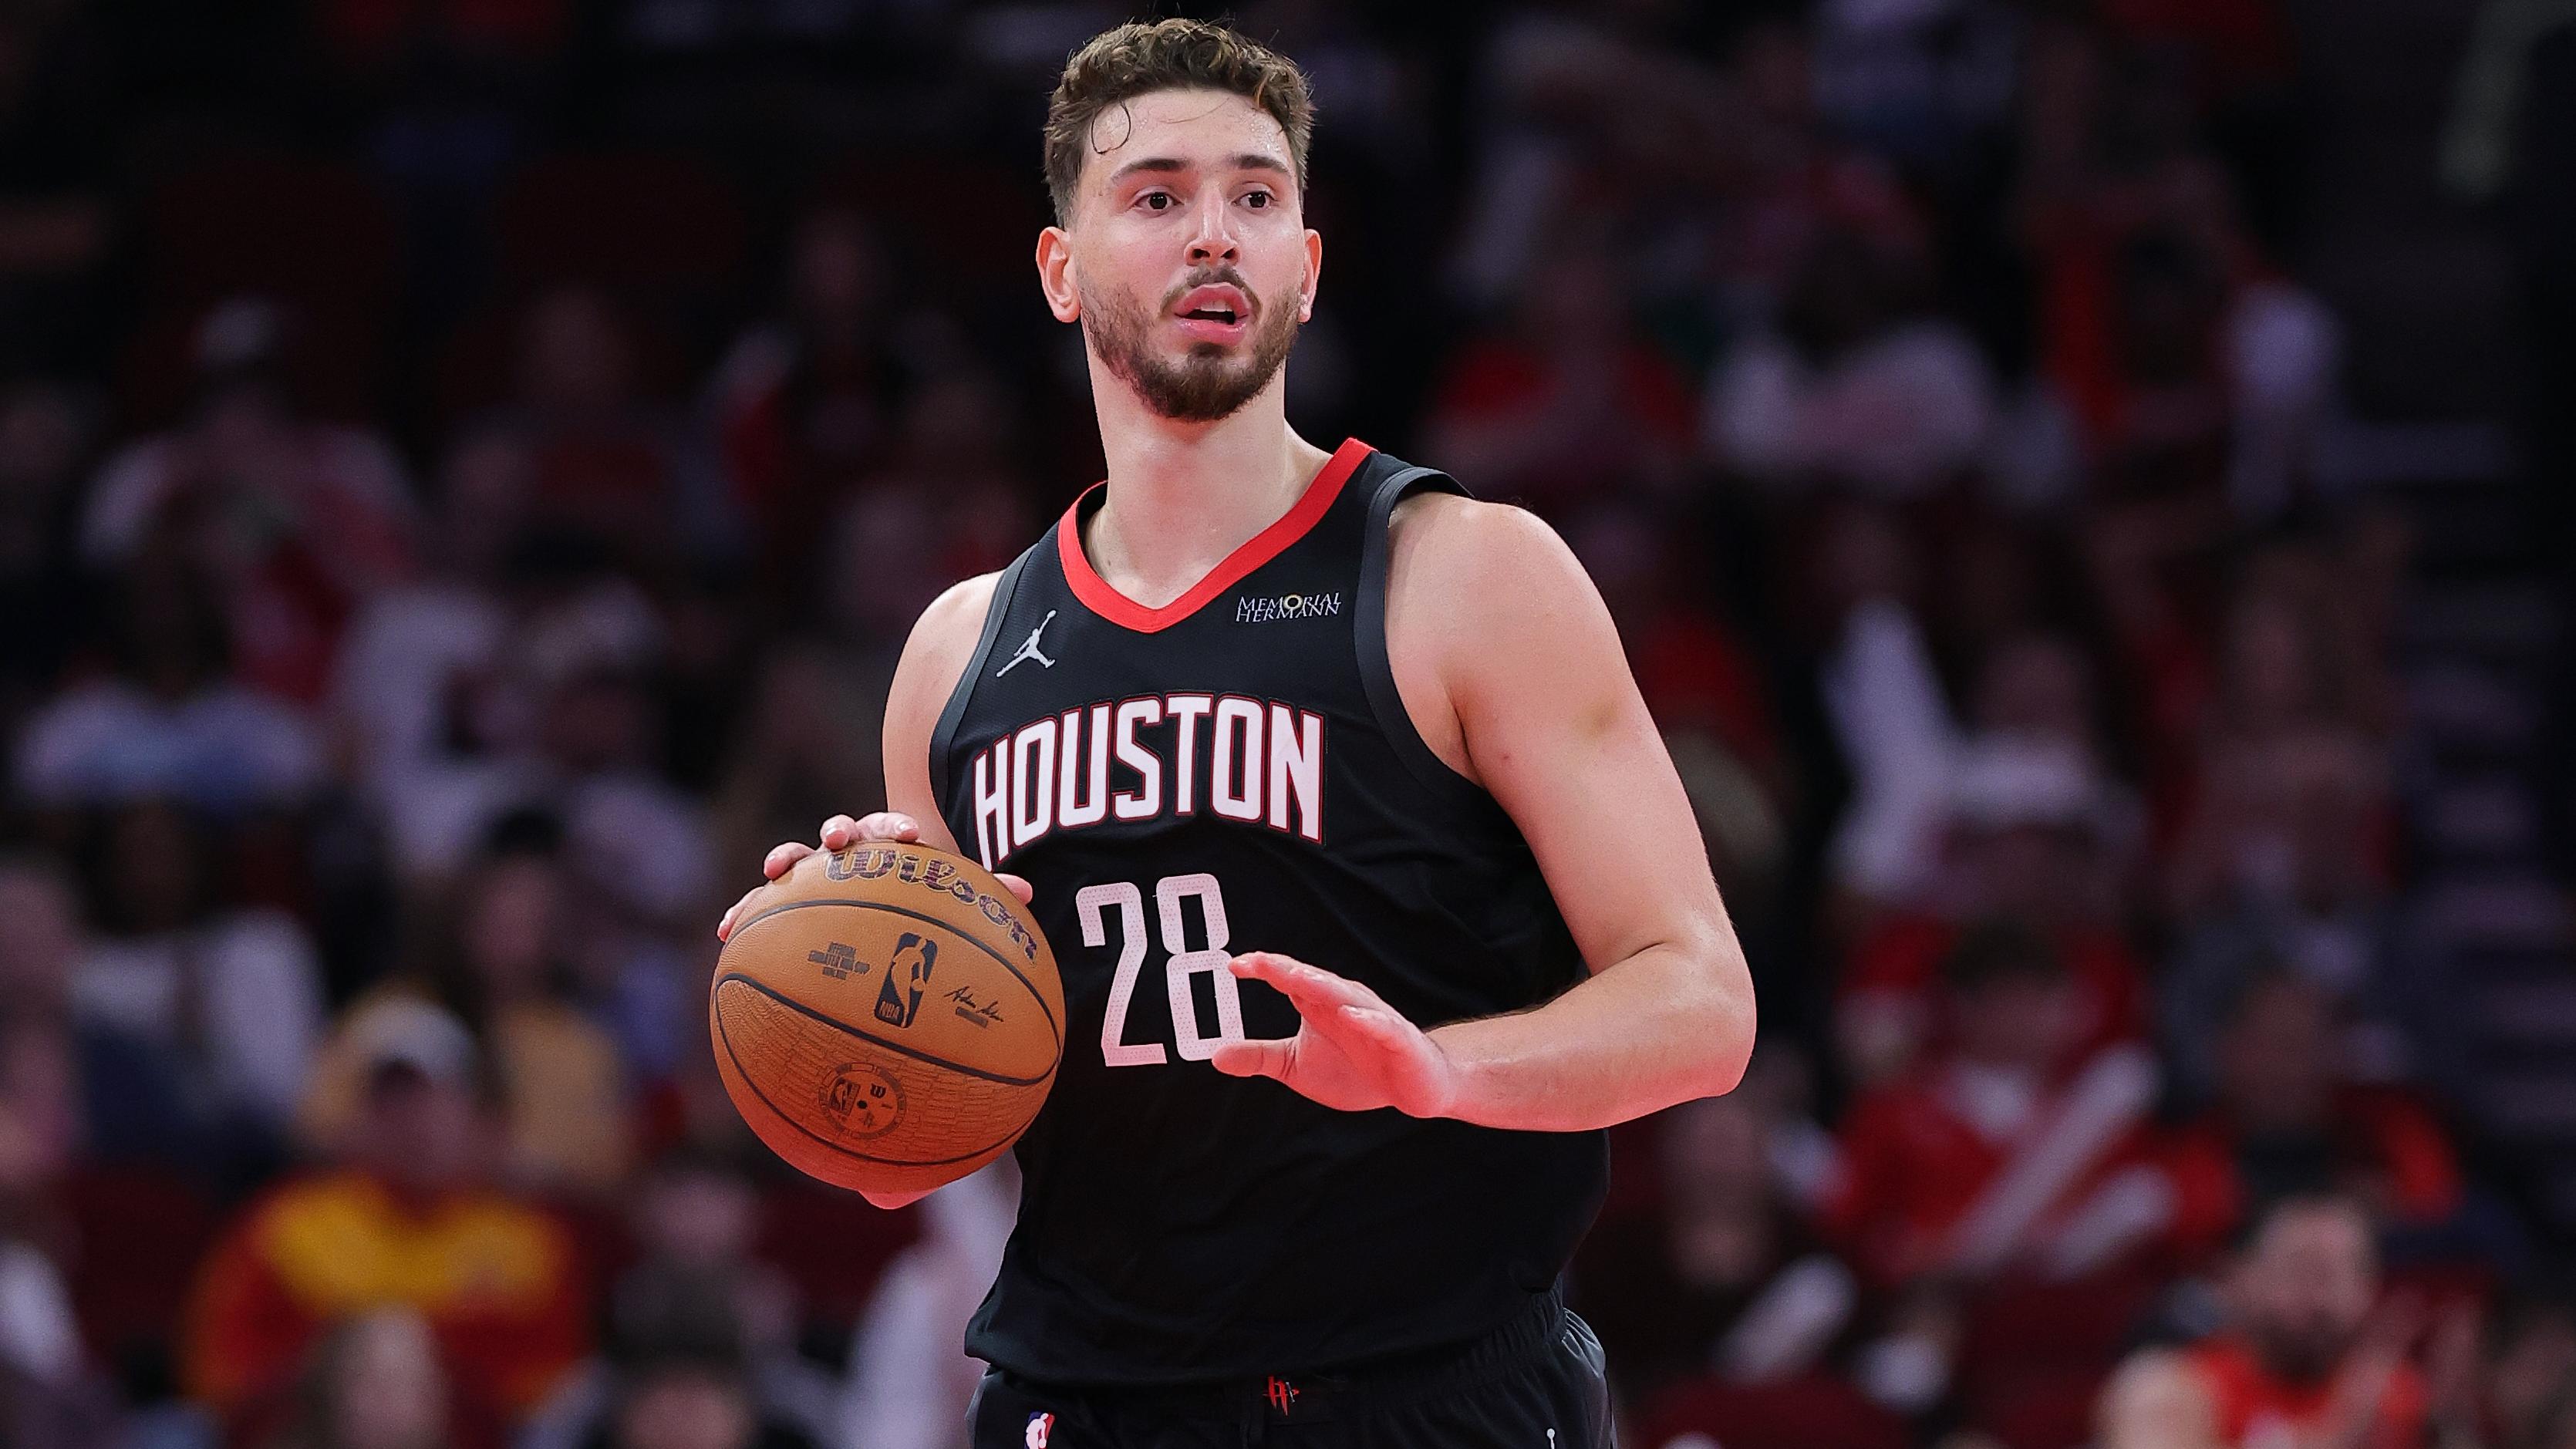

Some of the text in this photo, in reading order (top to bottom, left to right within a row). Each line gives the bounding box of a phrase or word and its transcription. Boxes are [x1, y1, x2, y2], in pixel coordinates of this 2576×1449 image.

[1236, 603, 1339, 622] HERMANN
[1237, 592, 1342, 612] MEMORIAL
[975, 693, 1323, 872] HOUSTON
[824, 849, 1037, 965] Wilson
[1076, 873, 1245, 1067] 28
[880, 1000, 901, 1020] NBA
